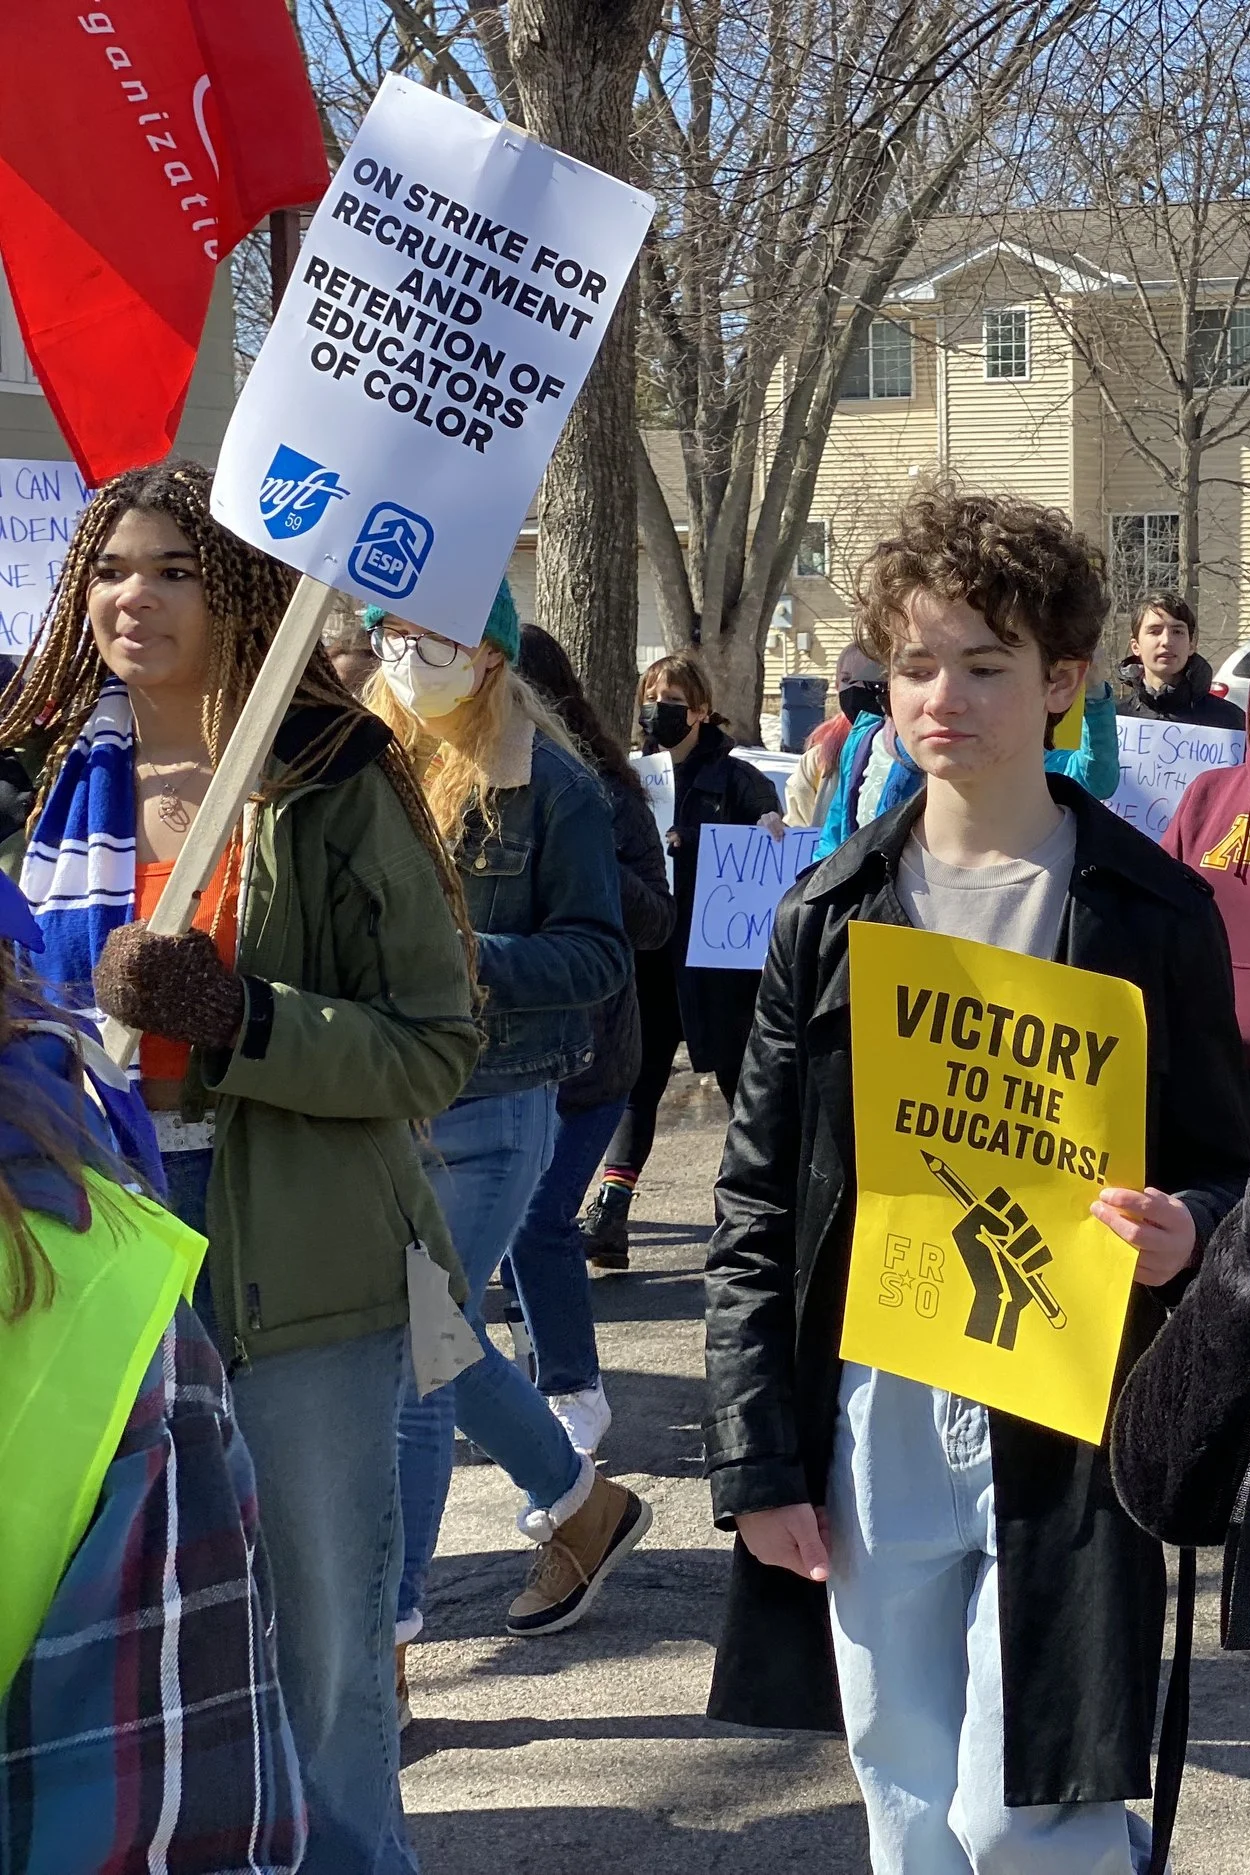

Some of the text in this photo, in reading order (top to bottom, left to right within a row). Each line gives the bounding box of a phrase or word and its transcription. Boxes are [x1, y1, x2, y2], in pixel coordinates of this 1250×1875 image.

[78, 0, 218, 261] ganizati
[331, 191, 594, 340] RECRUITMENT
[353, 158, 607, 304] ON STRIKE FOR
[303, 255, 565, 404] RETENTION OF
[395, 268, 482, 325] AND
[306, 297, 528, 429] EDUCATORS
[310, 341, 494, 454] OF COLOR
[16, 467, 60, 501] CAN
[259, 467, 349, 521] mft
[284, 512, 302, 530] 59
[367, 548, 404, 575] ESP
[896, 985, 1119, 1087] VICTORY
[946, 1060, 1064, 1124] TO THE
[895, 1099, 1110, 1185] EDUCATORS!
